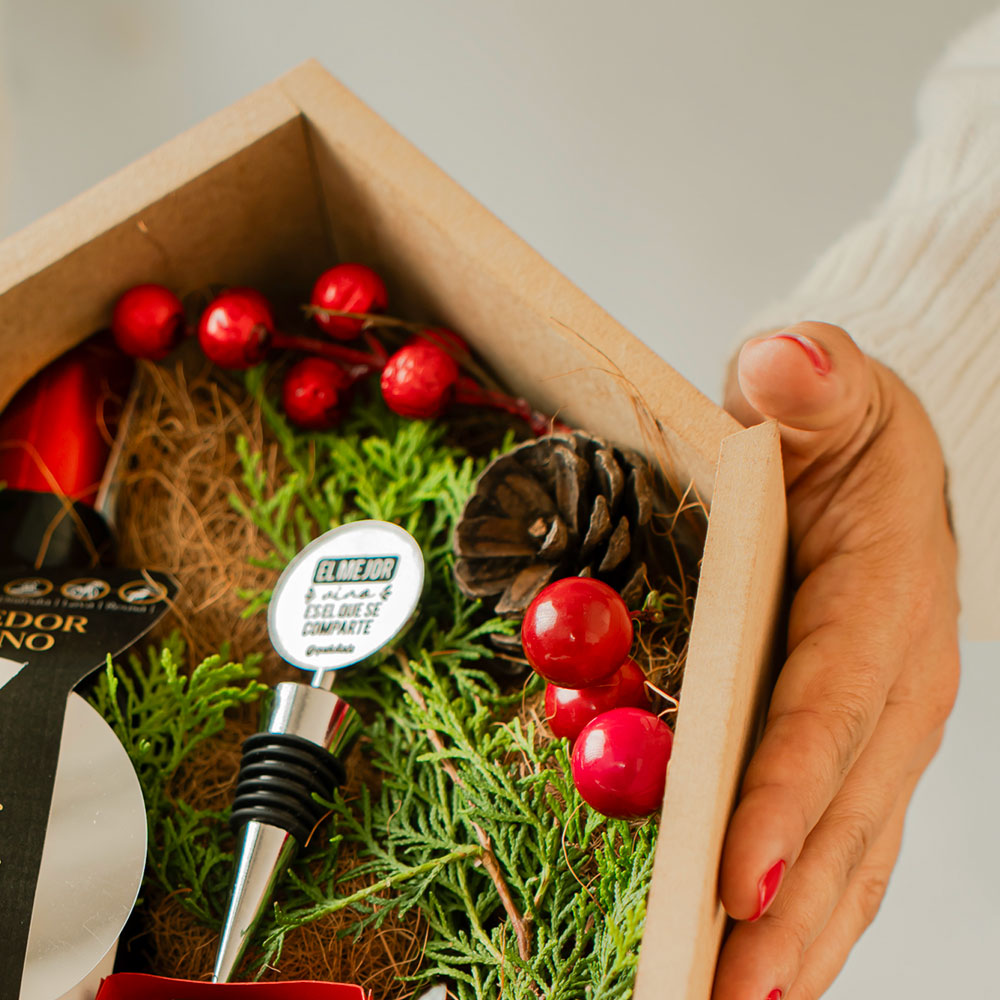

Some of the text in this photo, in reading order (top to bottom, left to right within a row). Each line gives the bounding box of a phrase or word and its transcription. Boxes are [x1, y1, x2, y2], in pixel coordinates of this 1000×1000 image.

[316, 558, 395, 581] EL MEJOR
[337, 602, 363, 618] QUE
[364, 601, 382, 617] SE
[302, 619, 374, 636] COMPARTE
